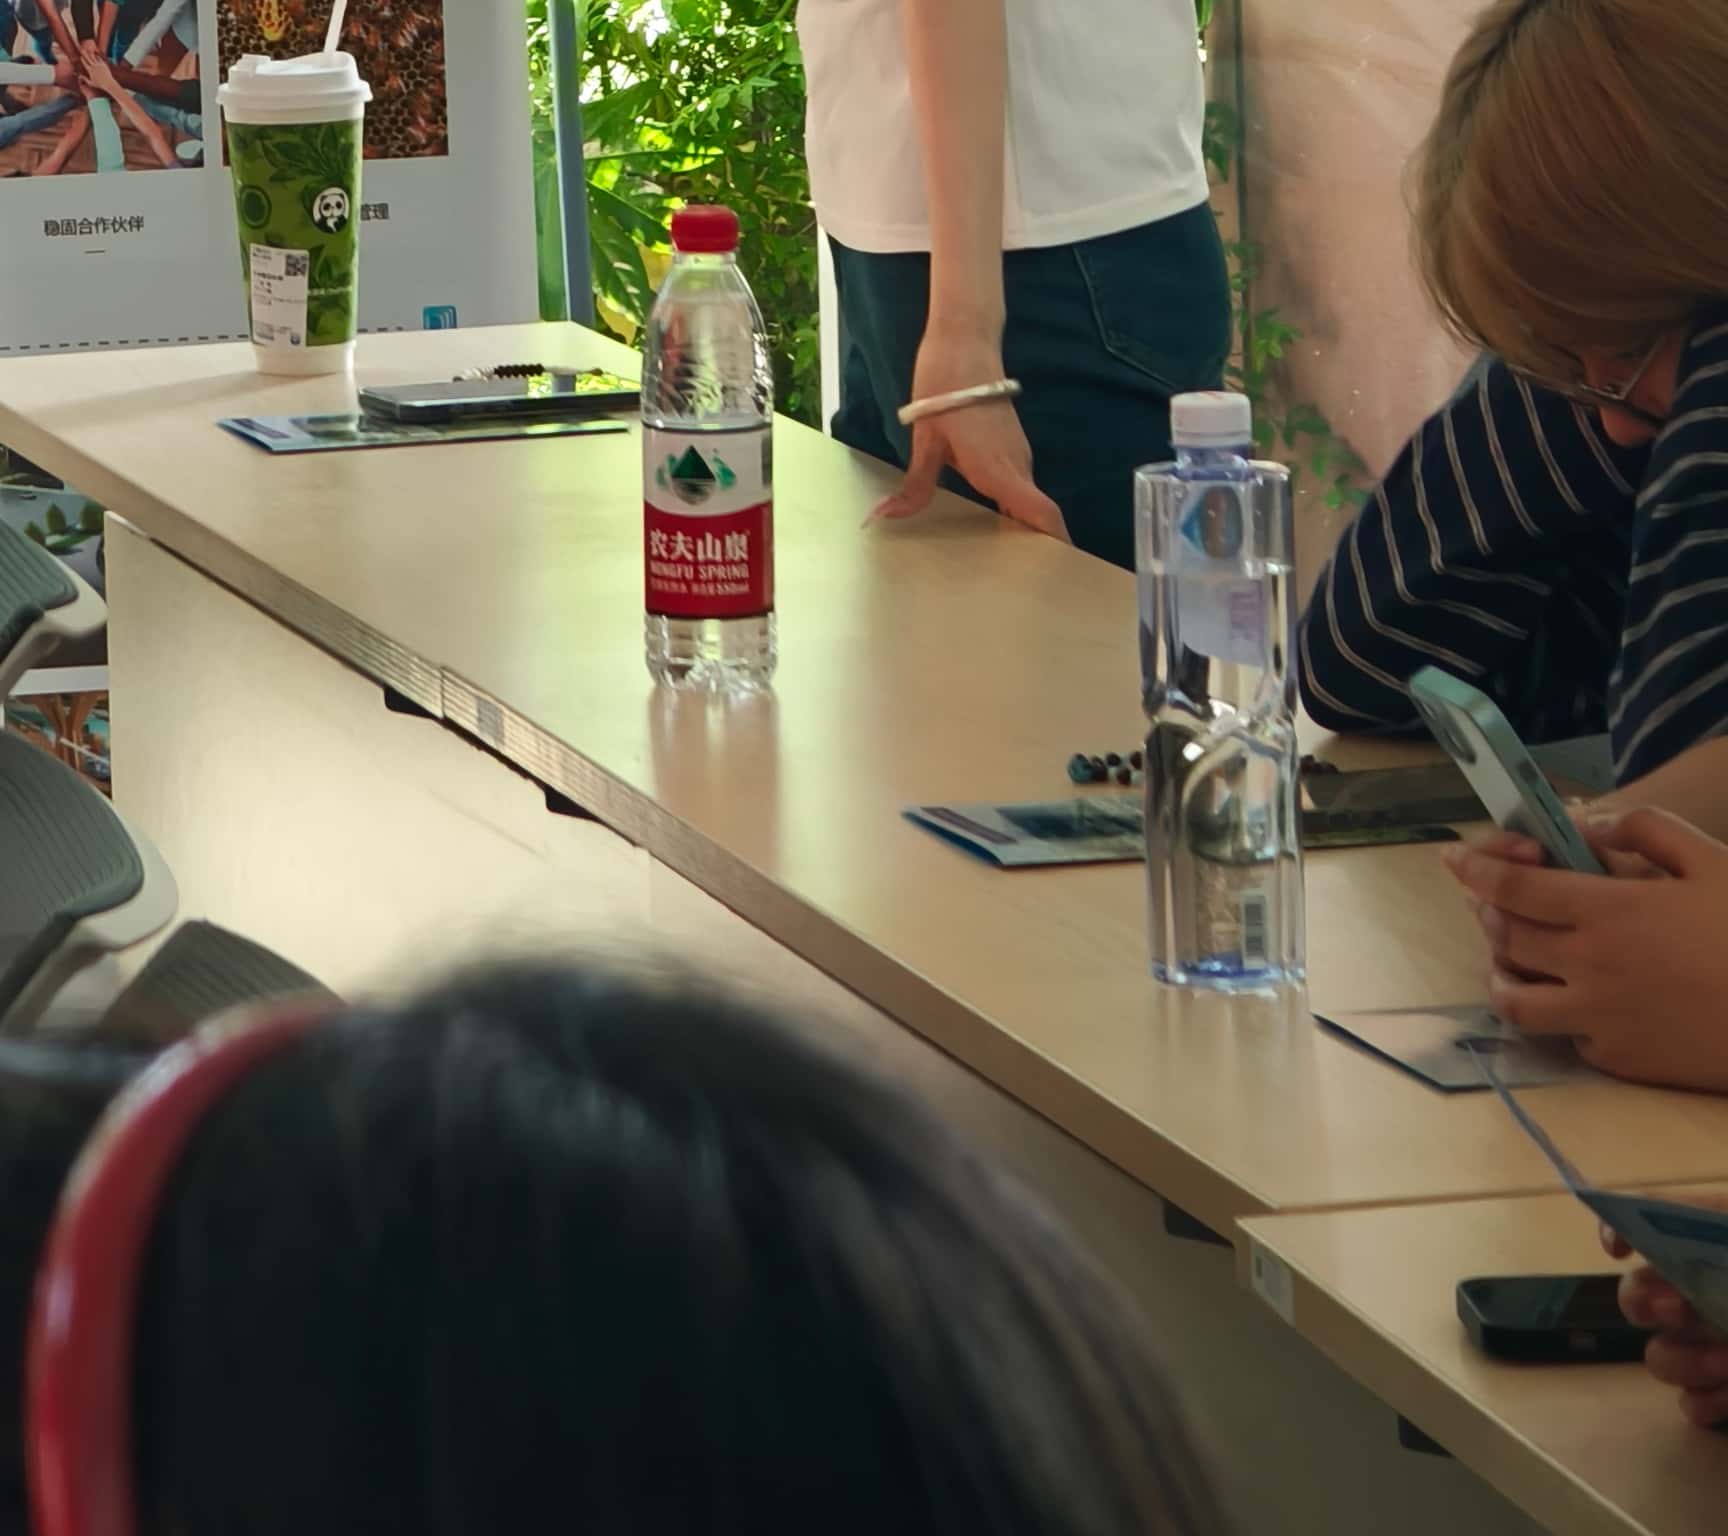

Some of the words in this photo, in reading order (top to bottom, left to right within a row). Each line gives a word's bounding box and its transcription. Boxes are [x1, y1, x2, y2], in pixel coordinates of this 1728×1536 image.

[43, 215, 145, 237] 稳固合作伙伴
